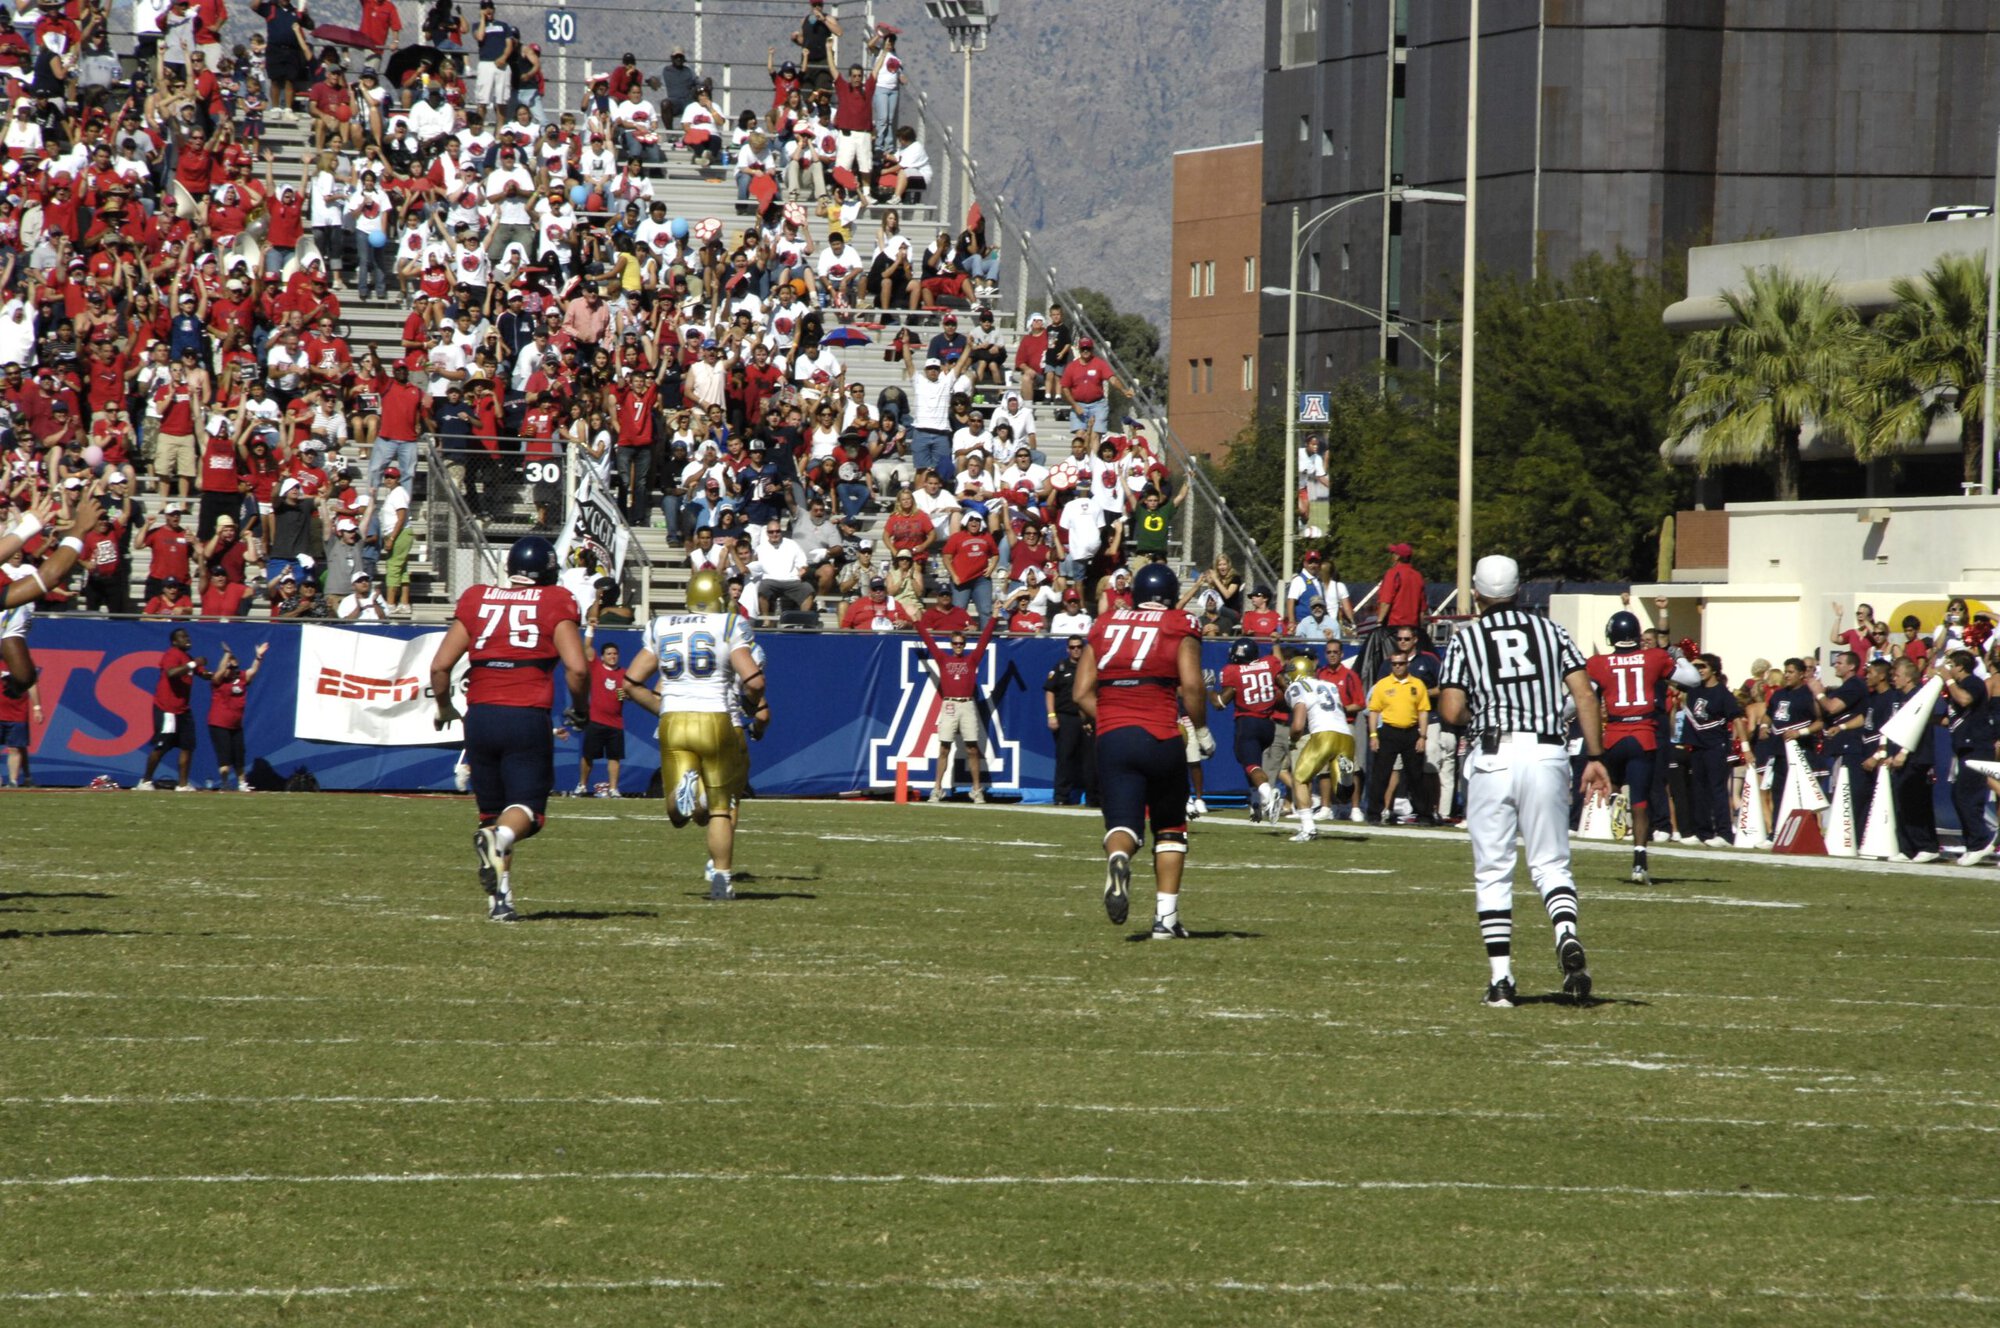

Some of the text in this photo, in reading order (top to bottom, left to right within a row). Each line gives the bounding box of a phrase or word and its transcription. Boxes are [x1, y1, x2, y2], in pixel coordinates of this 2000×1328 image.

[548, 13, 574, 41] 30
[634, 402, 644, 421] 7
[525, 462, 560, 483] 30
[474, 603, 540, 650] 75
[658, 630, 716, 680] 56
[1097, 624, 1159, 671] 77
[1490, 629, 1537, 679] R
[316, 667, 420, 702] ESPN
[1241, 672, 1275, 705] 28
[1612, 667, 1648, 707] 11
[1777, 815, 1803, 847] 10
